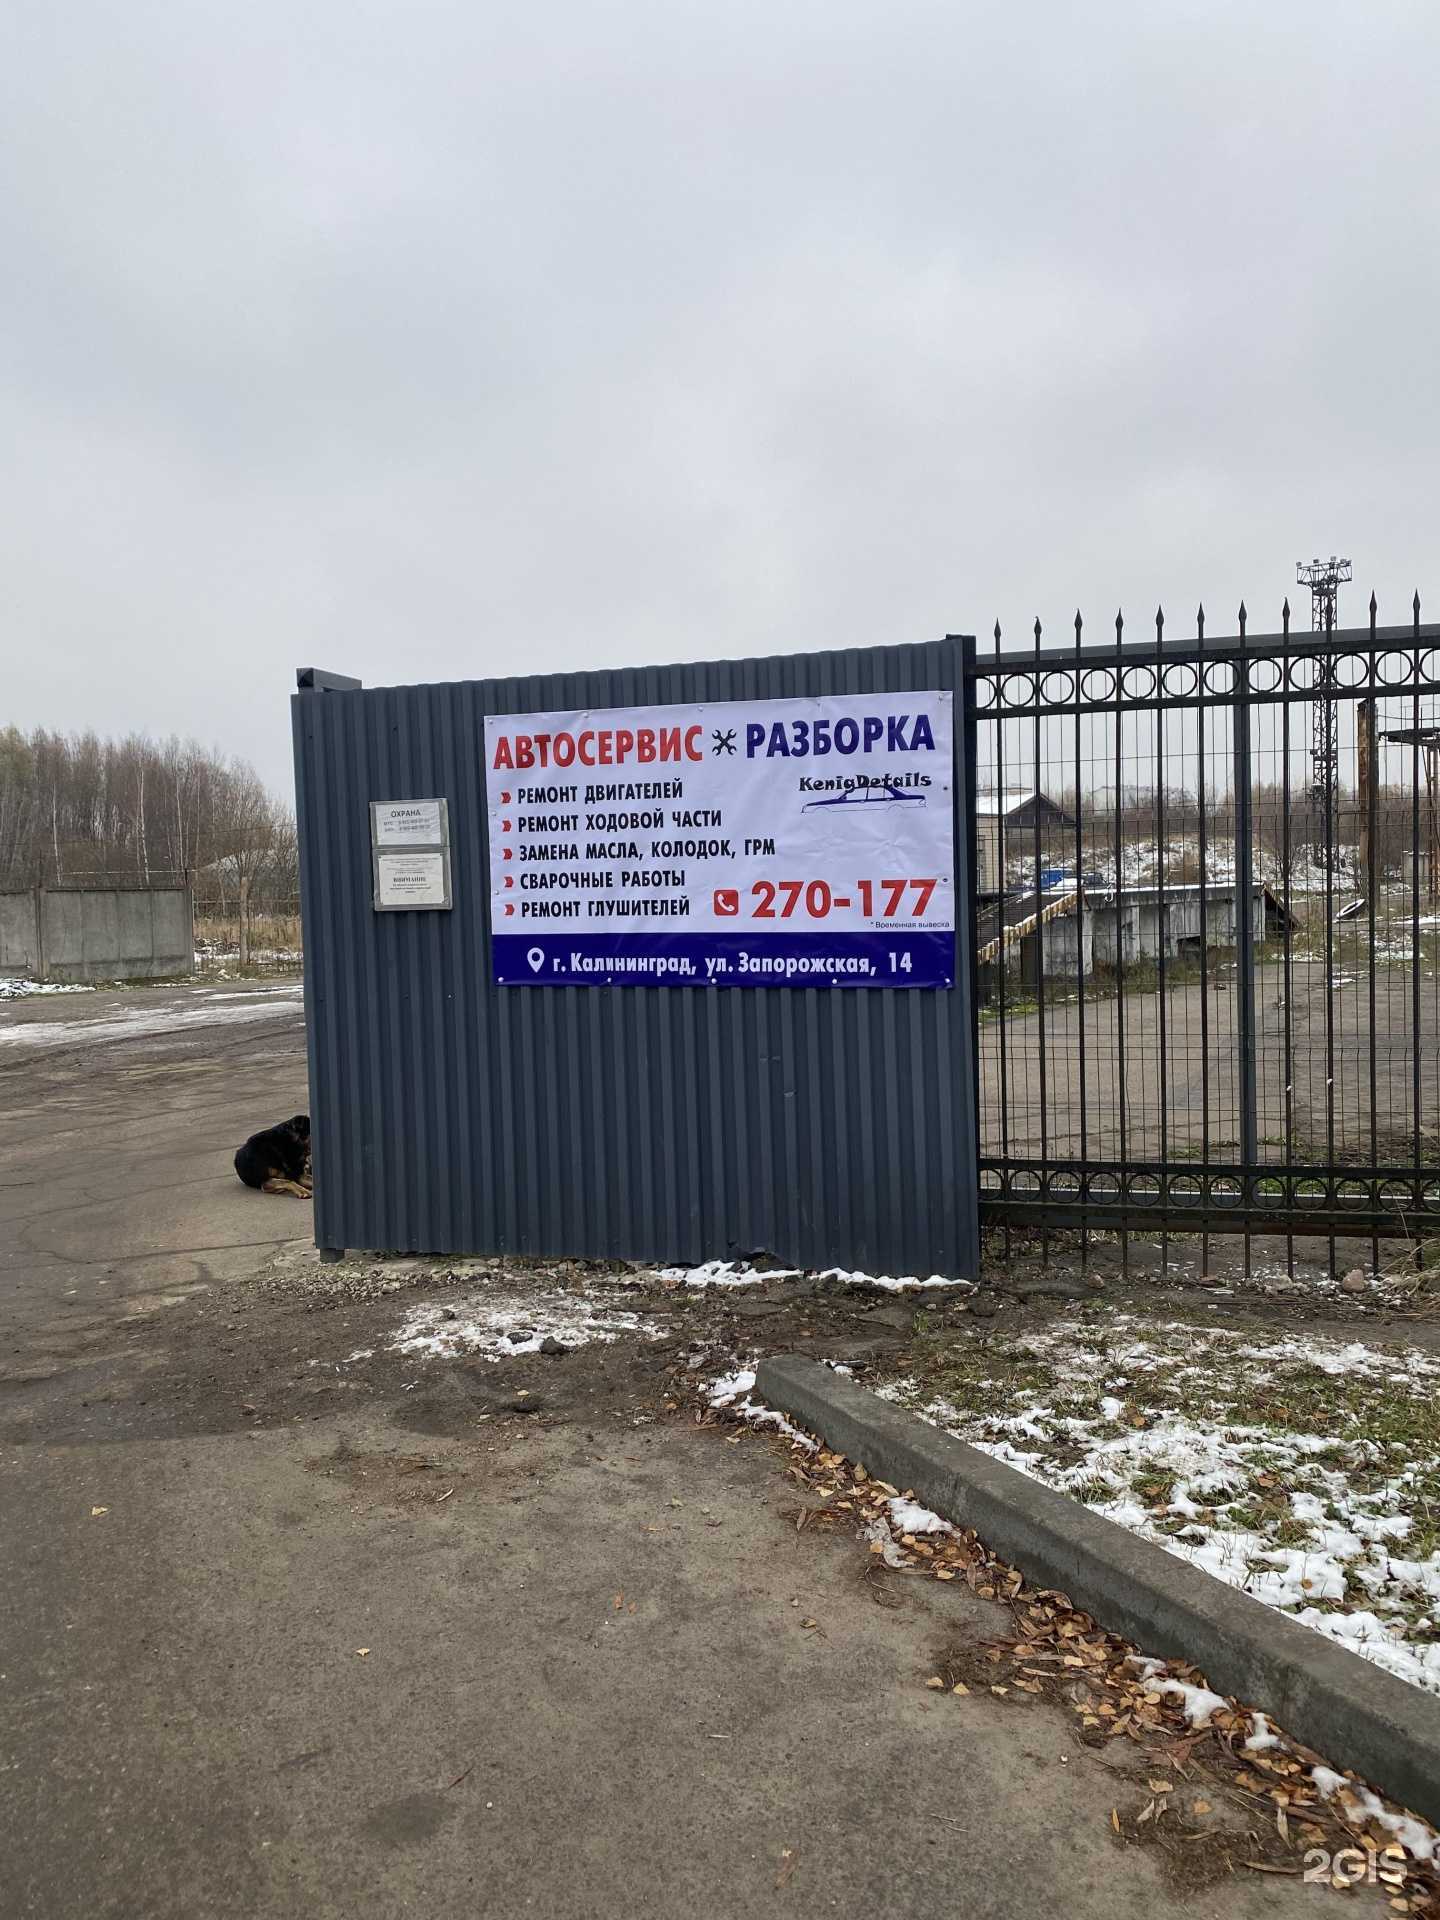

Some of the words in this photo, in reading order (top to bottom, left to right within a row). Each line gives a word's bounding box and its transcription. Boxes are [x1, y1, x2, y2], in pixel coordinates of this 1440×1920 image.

[493, 725, 703, 769] АВТОСЕРВИС
[746, 714, 935, 758] РАЗБОРКА
[517, 786, 578, 804] РЕМОНТ
[585, 777, 683, 804] ДВИГАТЕЛЕЙ
[799, 772, 932, 794] KenigDetails
[391, 809, 421, 817] ОХРАНА
[518, 815, 579, 832] РЕМОНТ
[586, 808, 664, 832] ХОДОВОЙ
[672, 810, 722, 828] ЧАСТИ
[519, 843, 579, 861] ЗАМЕНА
[586, 842, 643, 861] МАСЛА,
[651, 839, 735, 860] КОЛОДОК,
[744, 838, 775, 855] ГРМ
[520, 871, 613, 889] СВАРОЧНЫЕ
[621, 870, 685, 887] РАБОТЫ
[521, 901, 580, 917] РЕМОНТ
[588, 895, 689, 916] ГЛУШИТЕЛЕЙ
[752, 879, 938, 918] 270-177
[875, 921, 917, 929] Временная
[553, 957, 567, 972] г.
[570, 952, 697, 976] Калининград,
[705, 957, 734, 976] ул.
[738, 952, 876, 977] Запорожская,
[889, 952, 913, 972] 14
